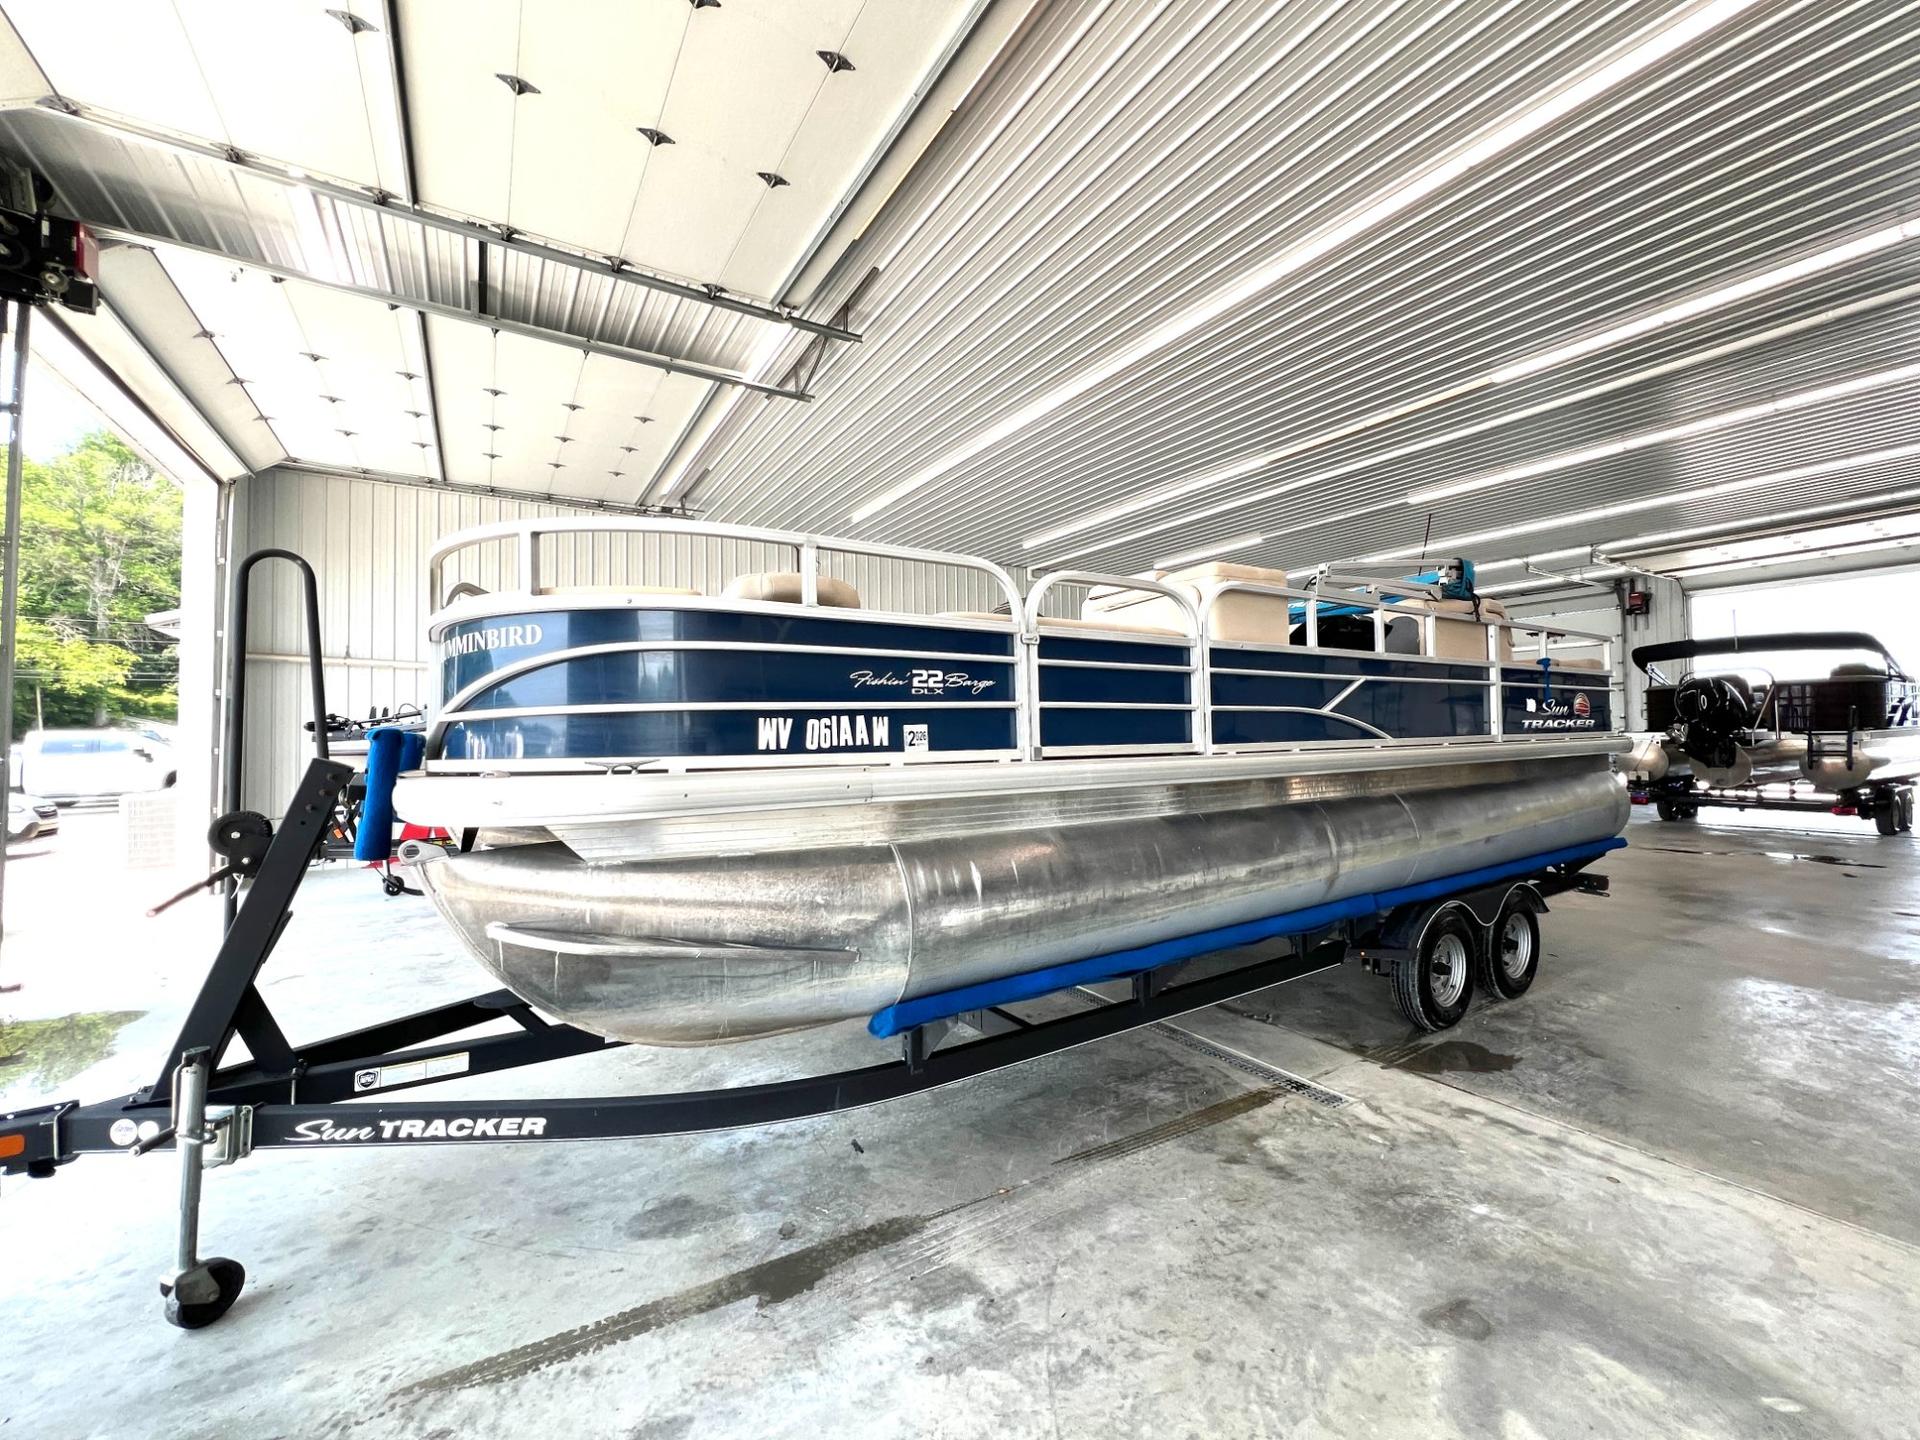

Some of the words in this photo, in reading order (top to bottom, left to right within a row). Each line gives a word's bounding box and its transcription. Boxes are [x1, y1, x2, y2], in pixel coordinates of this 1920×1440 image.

[849, 670, 911, 688] Fishin'
[911, 669, 944, 688] 22
[944, 672, 996, 694] Barge
[1538, 698, 1569, 716] Sun
[757, 717, 794, 751] WV
[1521, 719, 1596, 729] TRACKER
[284, 1118, 376, 1142] Sun
[378, 1116, 548, 1139] TRACKER
